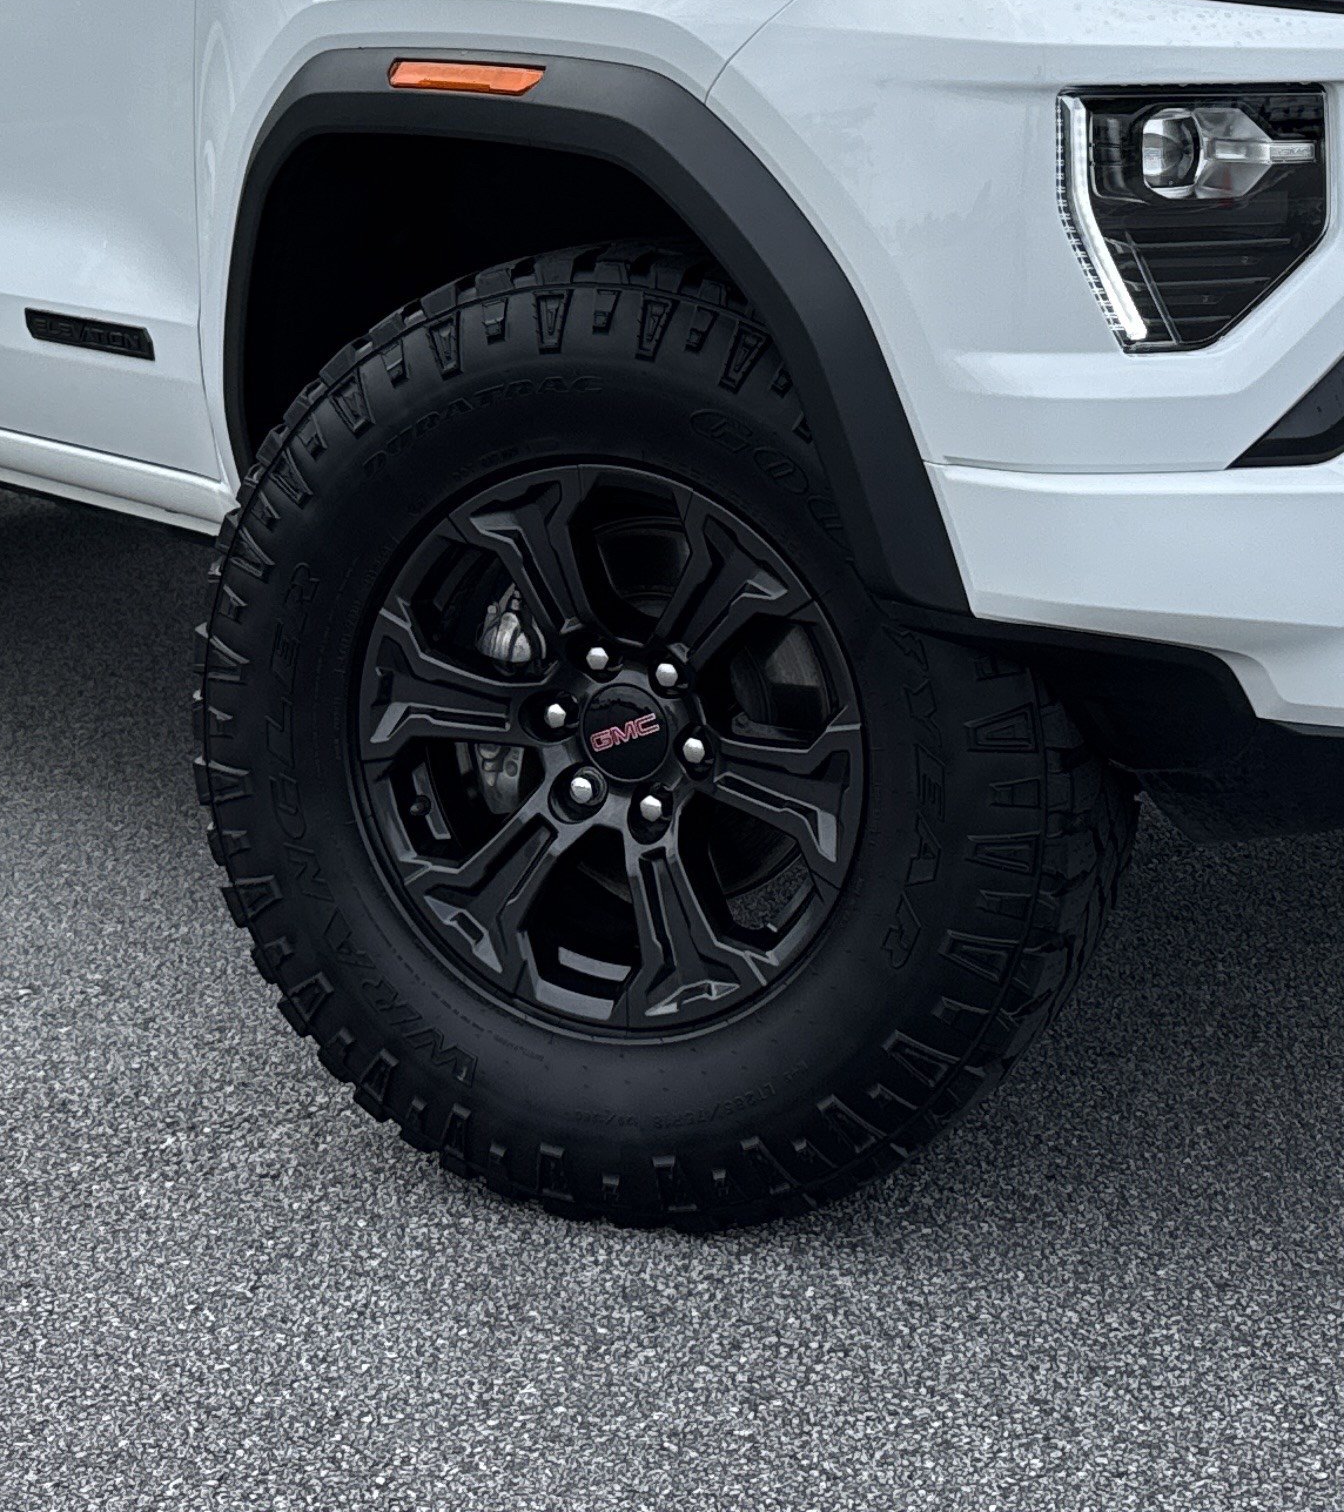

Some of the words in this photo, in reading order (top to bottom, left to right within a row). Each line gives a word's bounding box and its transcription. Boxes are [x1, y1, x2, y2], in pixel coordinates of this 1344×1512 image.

[361, 375, 604, 477] DURATRAC
[590, 713, 660, 753] GMC
[264, 561, 479, 1088] WRANGLER
